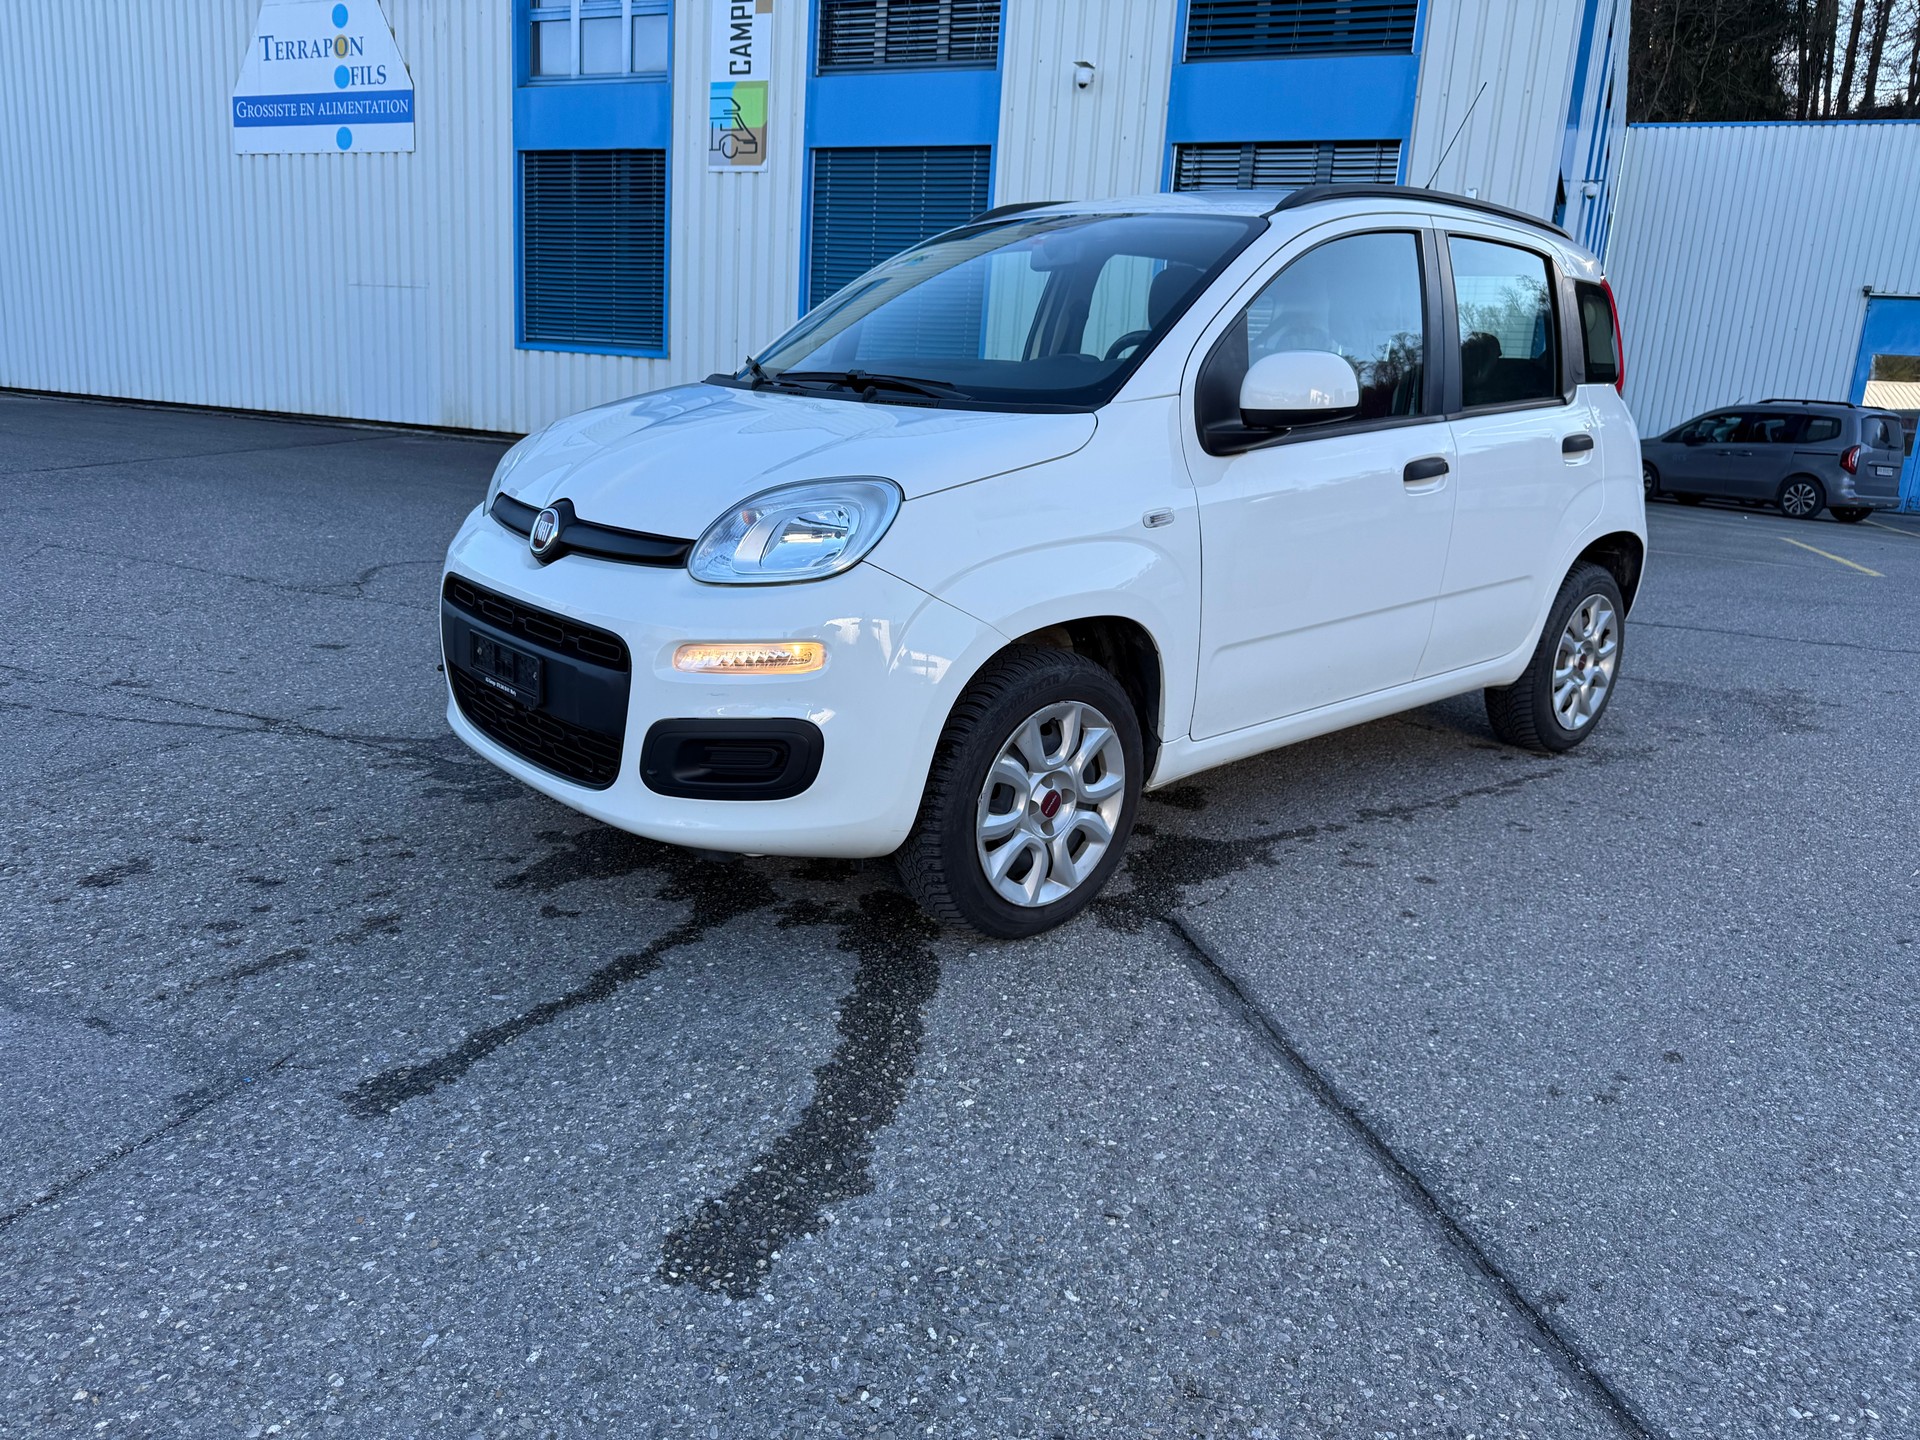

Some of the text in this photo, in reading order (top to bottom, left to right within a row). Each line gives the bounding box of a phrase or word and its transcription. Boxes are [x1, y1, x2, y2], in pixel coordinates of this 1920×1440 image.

[258, 34, 364, 61] TERRAPON
[350, 65, 387, 86] FILS
[236, 99, 409, 118] GROSSISTE EN ALIMENTATION
[534, 520, 554, 542] FIAT
